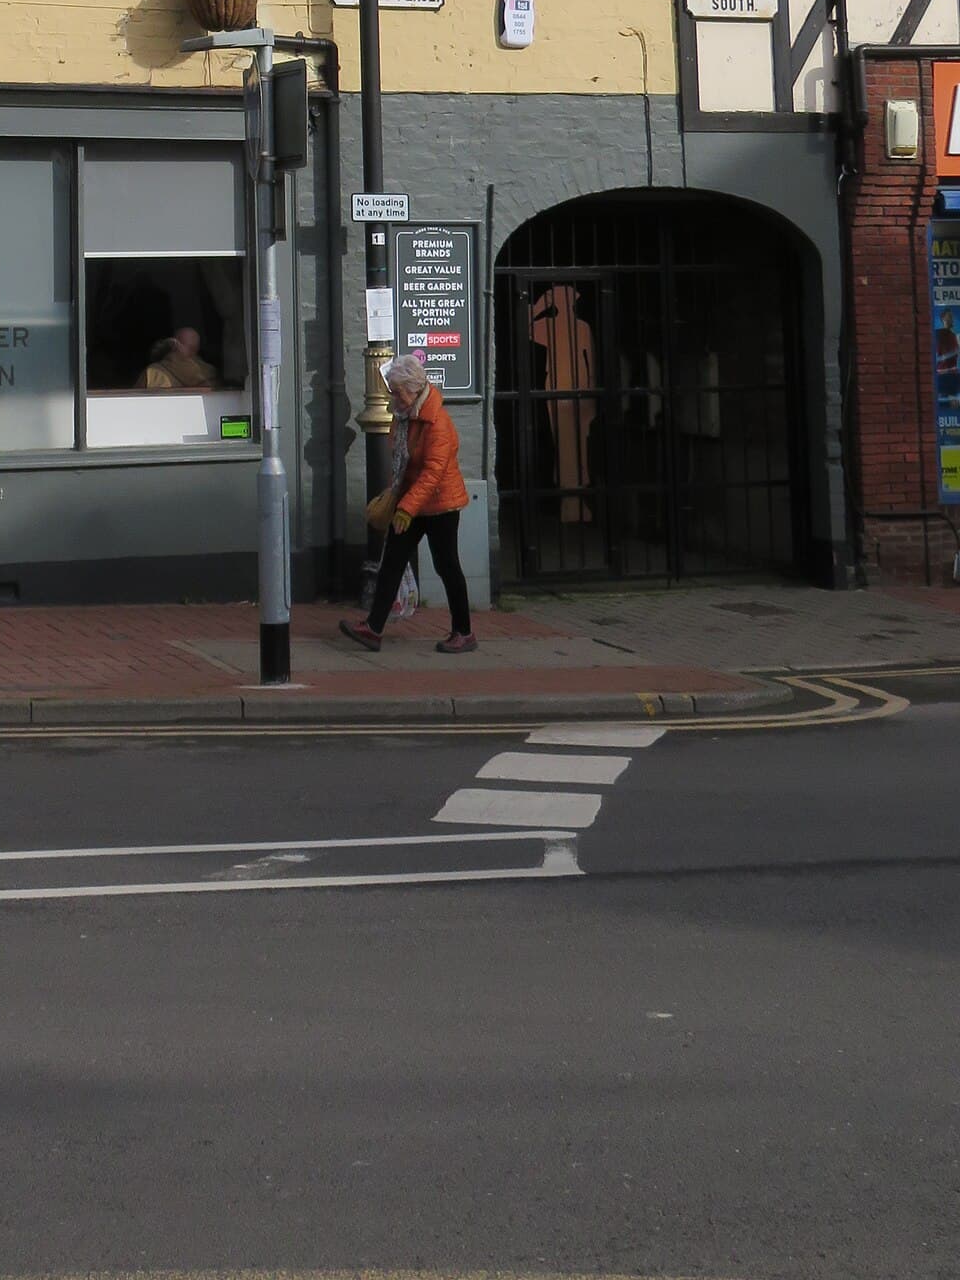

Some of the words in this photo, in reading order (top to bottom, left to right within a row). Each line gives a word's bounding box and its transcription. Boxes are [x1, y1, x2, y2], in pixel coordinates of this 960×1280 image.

[357, 199, 369, 207] No
[372, 199, 404, 208] loading
[356, 209, 365, 217] at
[368, 210, 383, 218] any
[386, 209, 405, 217] time
[412, 240, 453, 249] PREMIUM
[415, 249, 451, 258] BRANDS
[405, 266, 434, 274] GREAT
[434, 266, 462, 274] VALUE
[403, 283, 425, 291] BEER
[427, 282, 463, 291] GARDEN
[402, 300, 418, 308] ALL
[420, 300, 436, 308] THE
[438, 299, 465, 308] GREAT
[412, 308, 456, 317] SPORTING
[417, 318, 450, 326] ACTION
[409, 335, 426, 345] sky
[428, 336, 458, 344] sports
[427, 354, 456, 362] SPORTS
